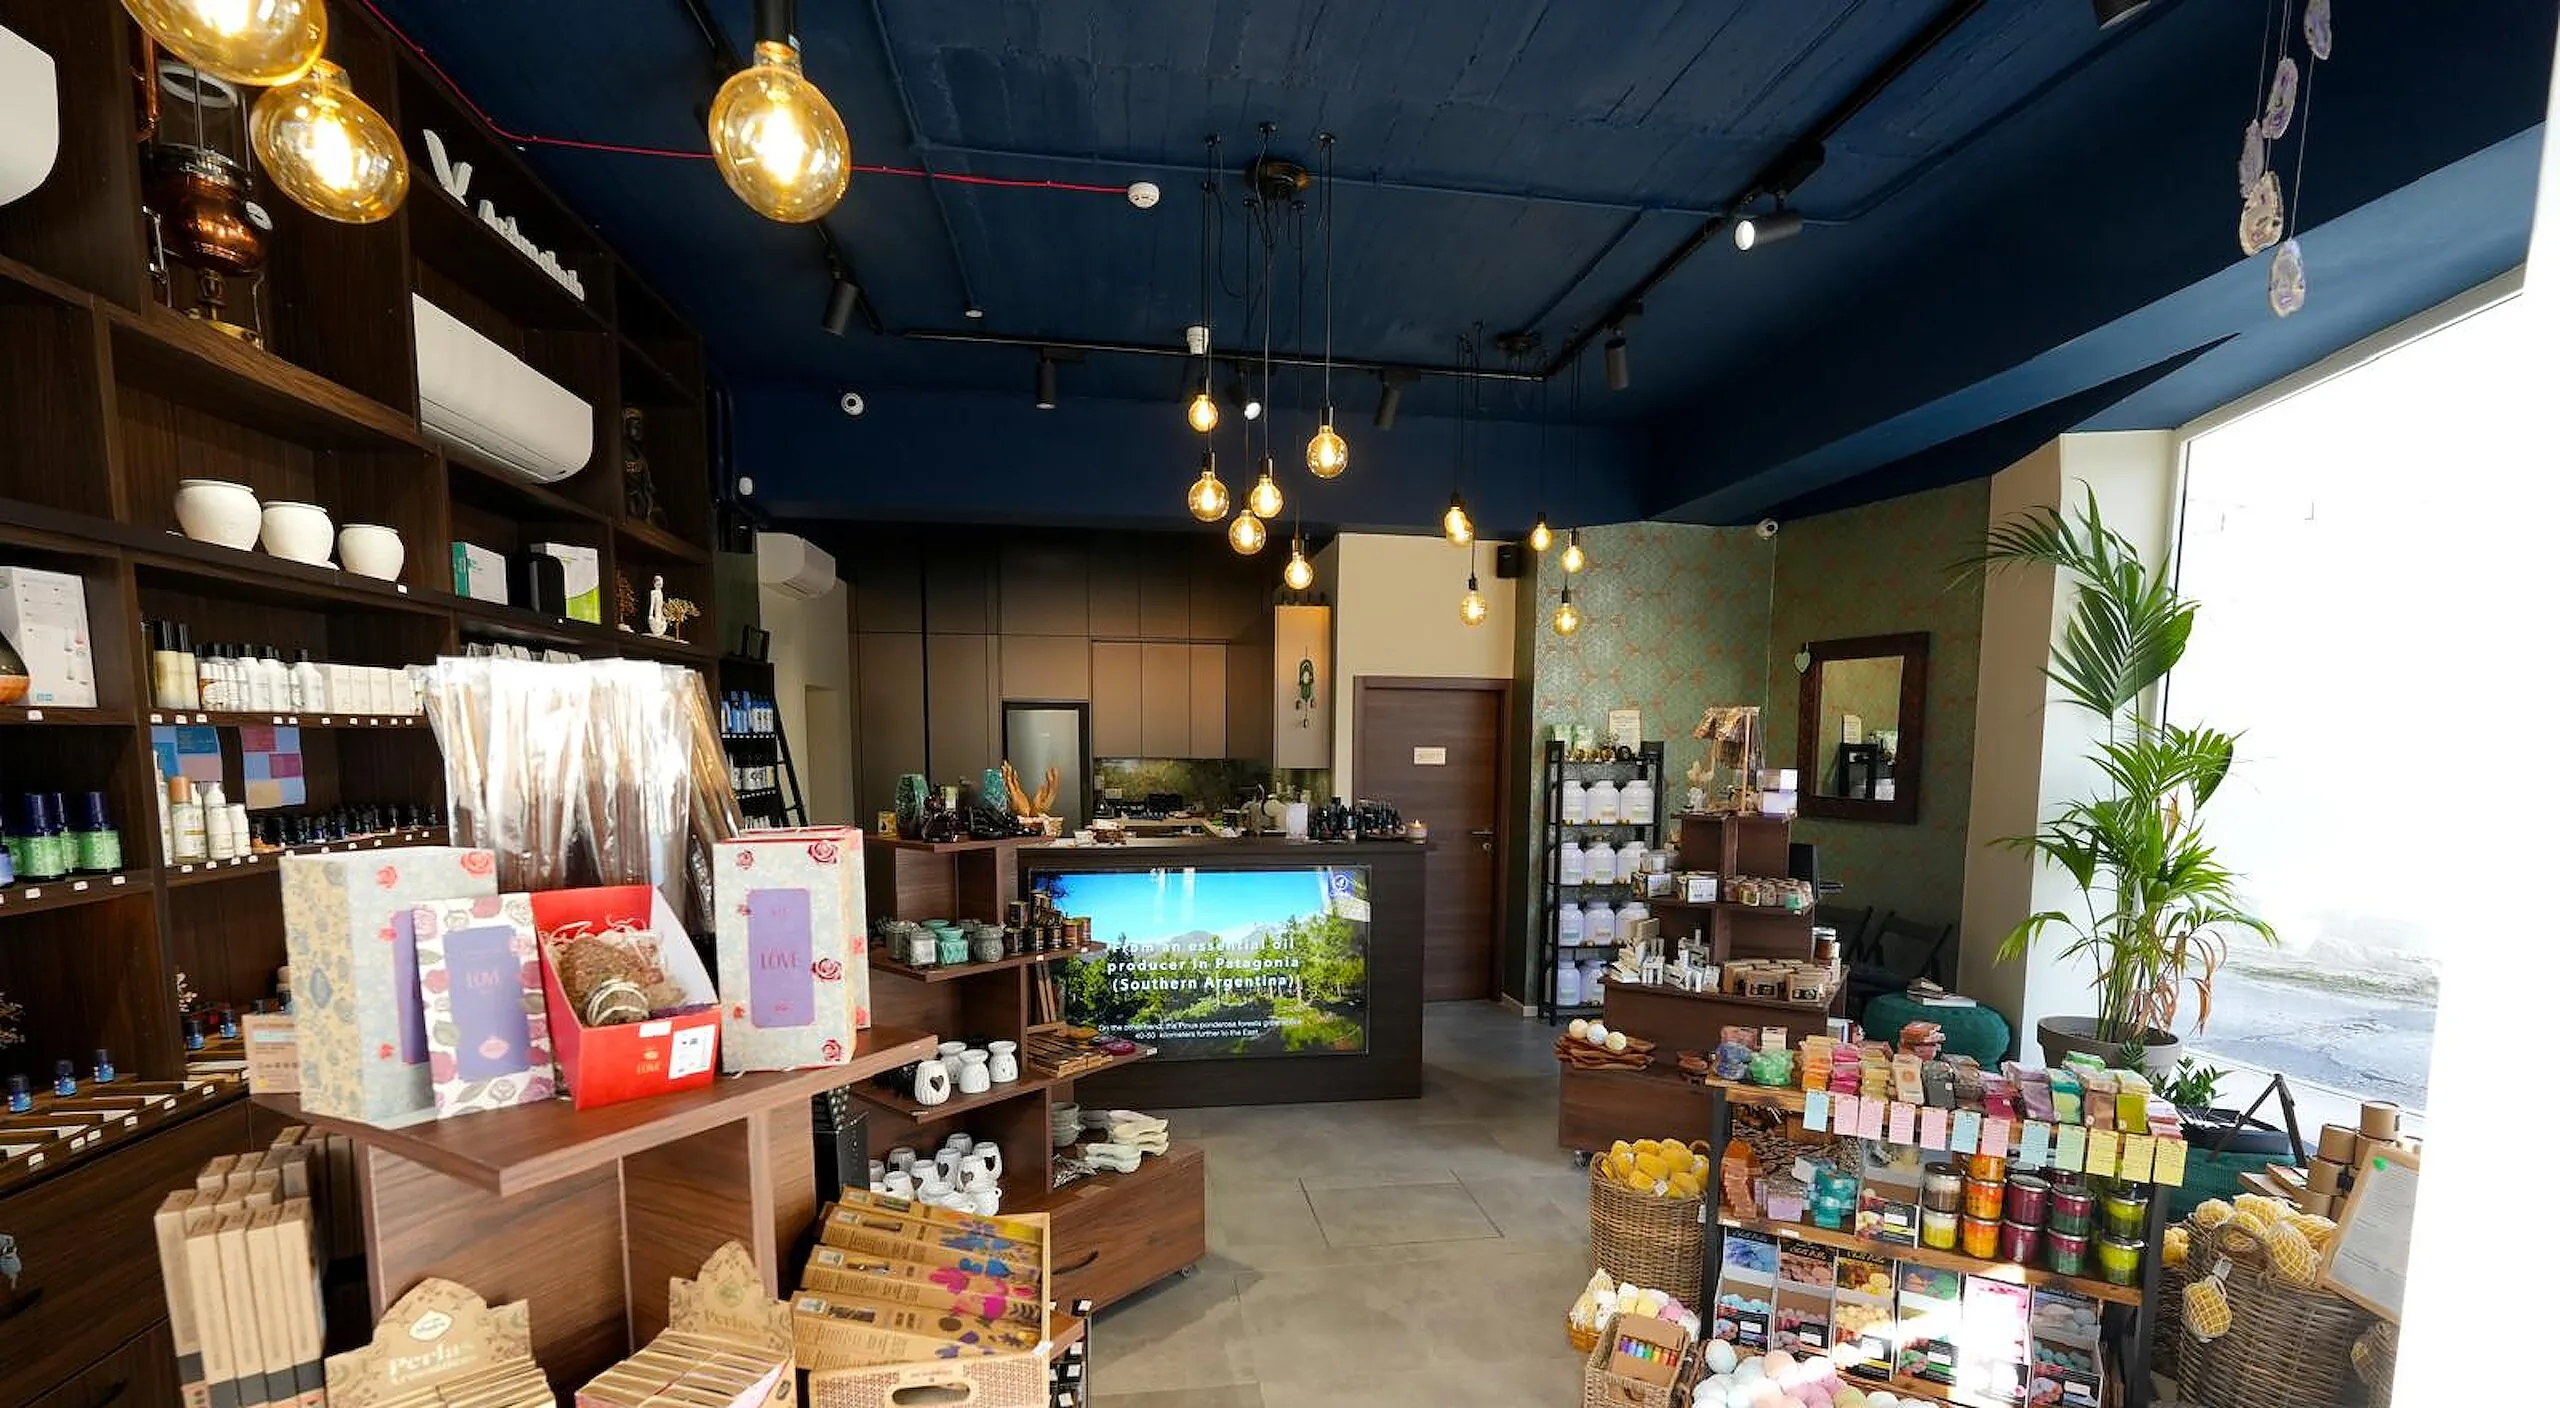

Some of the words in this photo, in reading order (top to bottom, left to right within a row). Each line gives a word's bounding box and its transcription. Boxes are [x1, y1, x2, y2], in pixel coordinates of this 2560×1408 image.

[1272, 935, 1295, 950] oil
[1107, 960, 1185, 975] producer
[1192, 958, 1209, 970] in
[1215, 957, 1300, 972] Patagonia
[1112, 976, 1198, 993] (Southern
[1203, 974, 1295, 991] Argentina)
